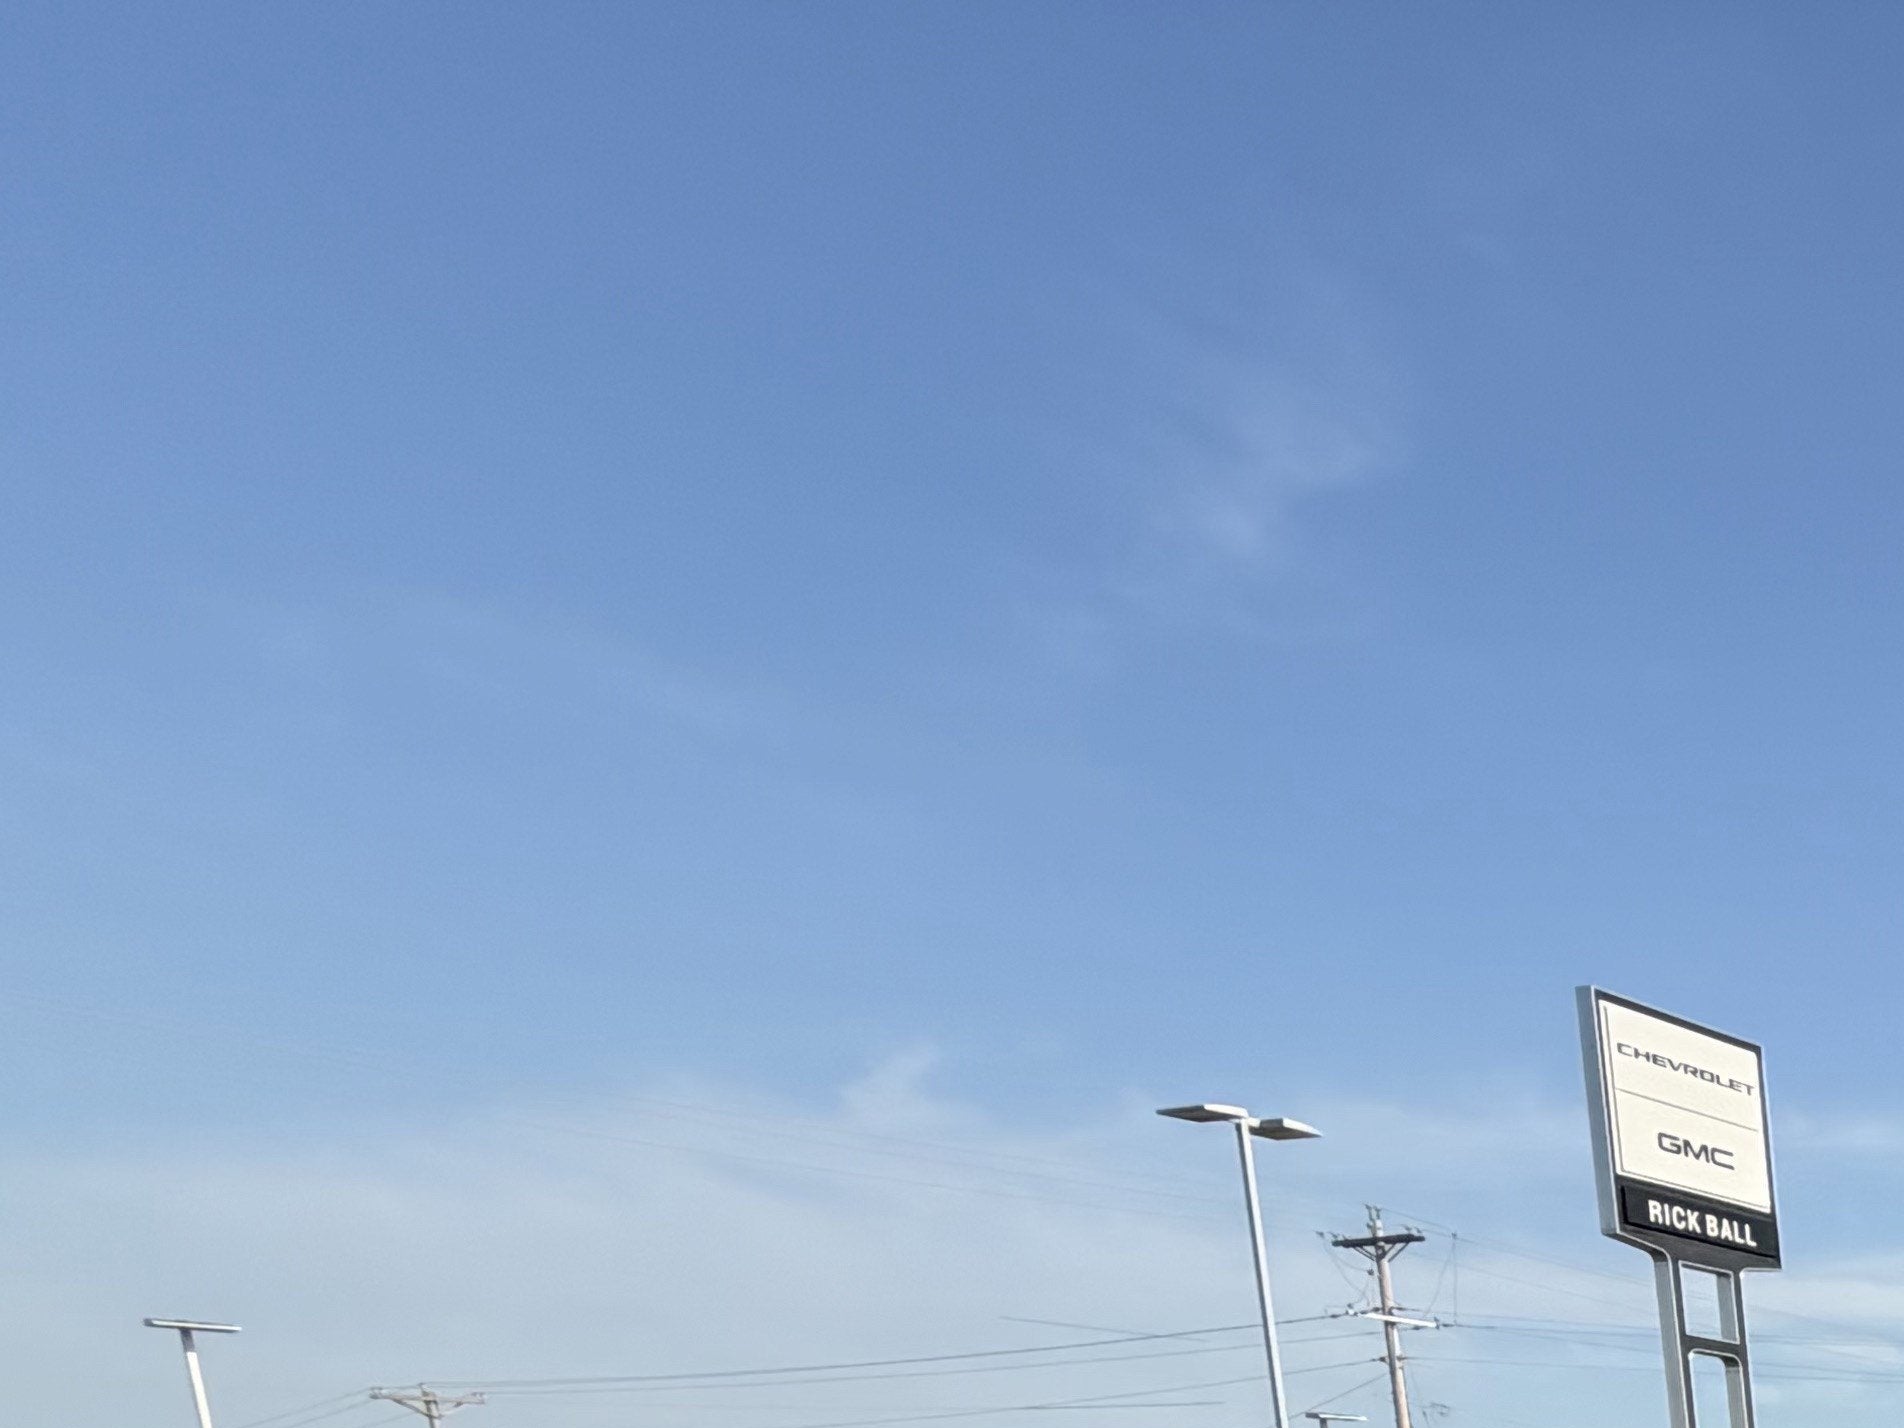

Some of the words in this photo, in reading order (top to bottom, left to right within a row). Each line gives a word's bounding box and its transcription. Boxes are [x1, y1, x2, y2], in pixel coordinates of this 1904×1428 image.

[1616, 1041, 1755, 1097] CHEVROLET
[1657, 1131, 1736, 1171] GMC
[1647, 1199, 1702, 1235] RICK
[1704, 1214, 1758, 1248] BALL
